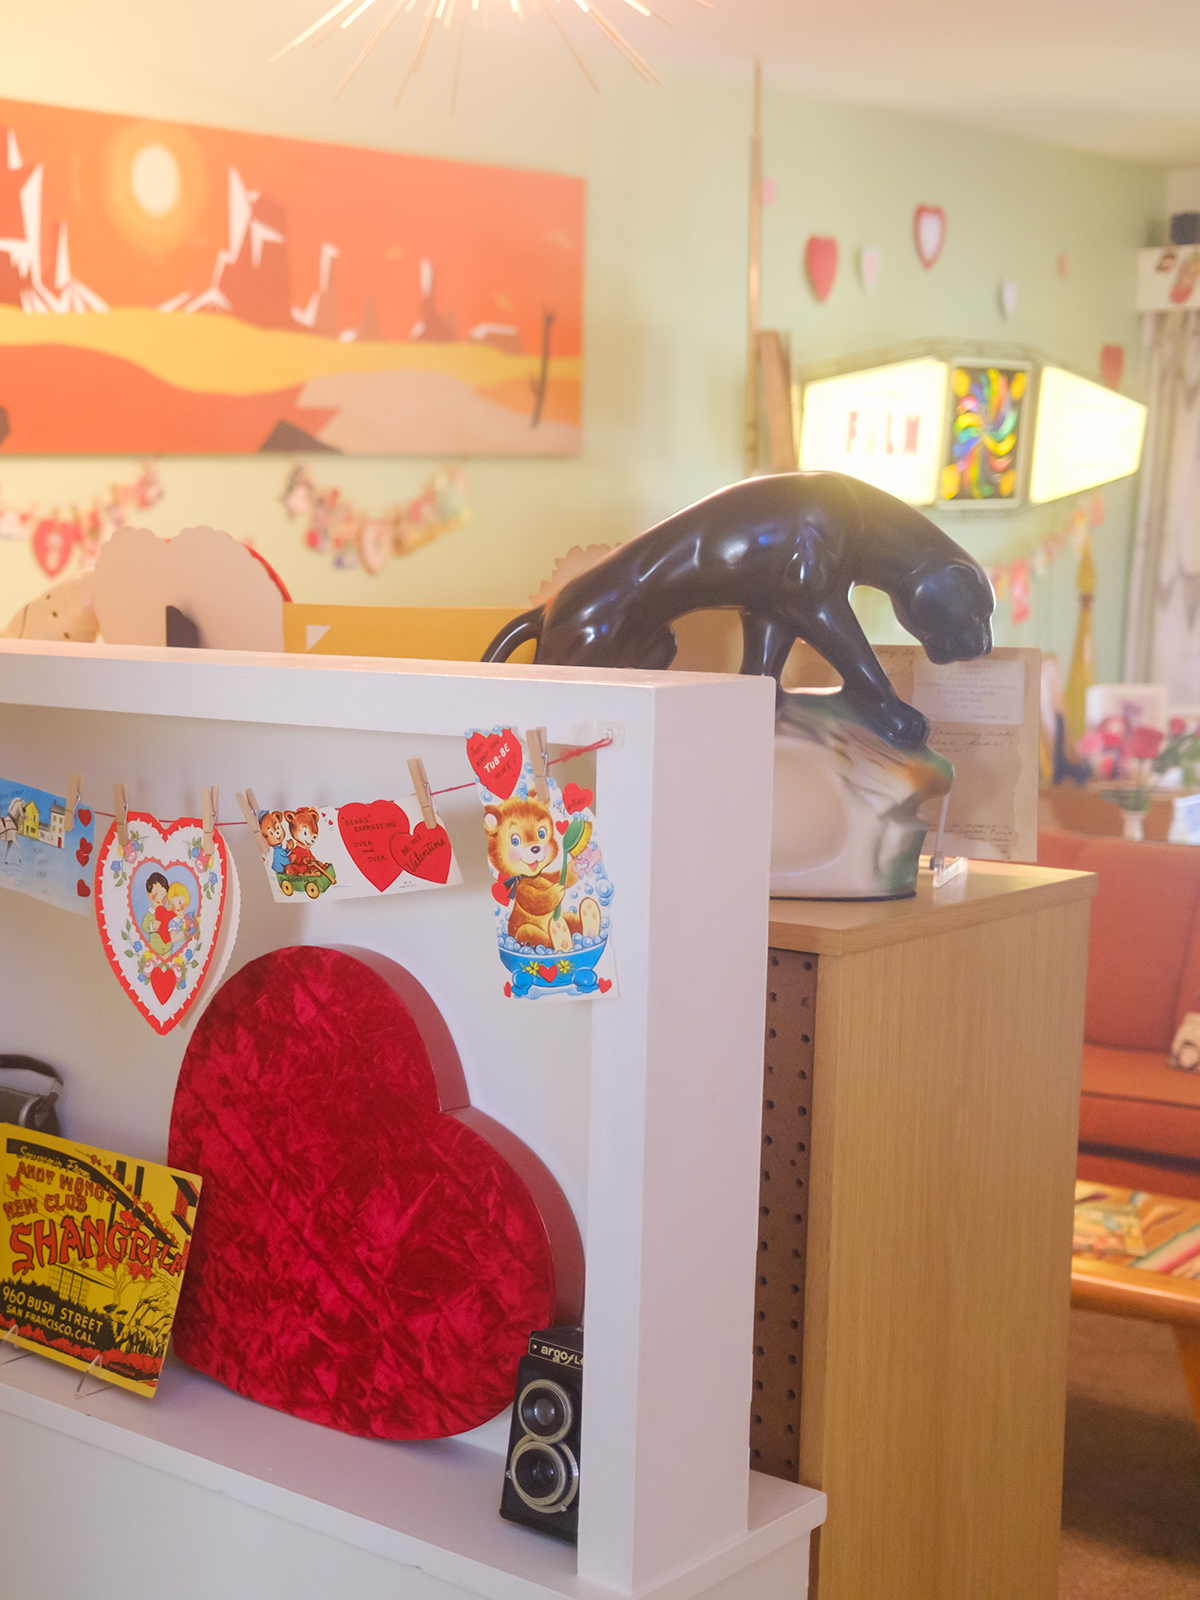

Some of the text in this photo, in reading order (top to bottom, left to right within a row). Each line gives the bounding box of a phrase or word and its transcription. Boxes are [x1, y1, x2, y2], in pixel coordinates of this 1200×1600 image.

[484, 742, 510, 773] TUB-BE
[353, 821, 397, 832] EXPRESSING
[353, 840, 373, 848] OVER
[400, 834, 423, 857] BE MY
[403, 837, 447, 873] Valentine
[367, 855, 386, 863] OVER
[16, 1145, 92, 1180] Souvenir From
[16, 1161, 117, 1203] ANDY WONG'S
[3, 1193, 88, 1221] NEW CLUB
[2, 1285, 104, 1333] 960 BUSH STREET
[6, 1304, 24, 1317] SAN
